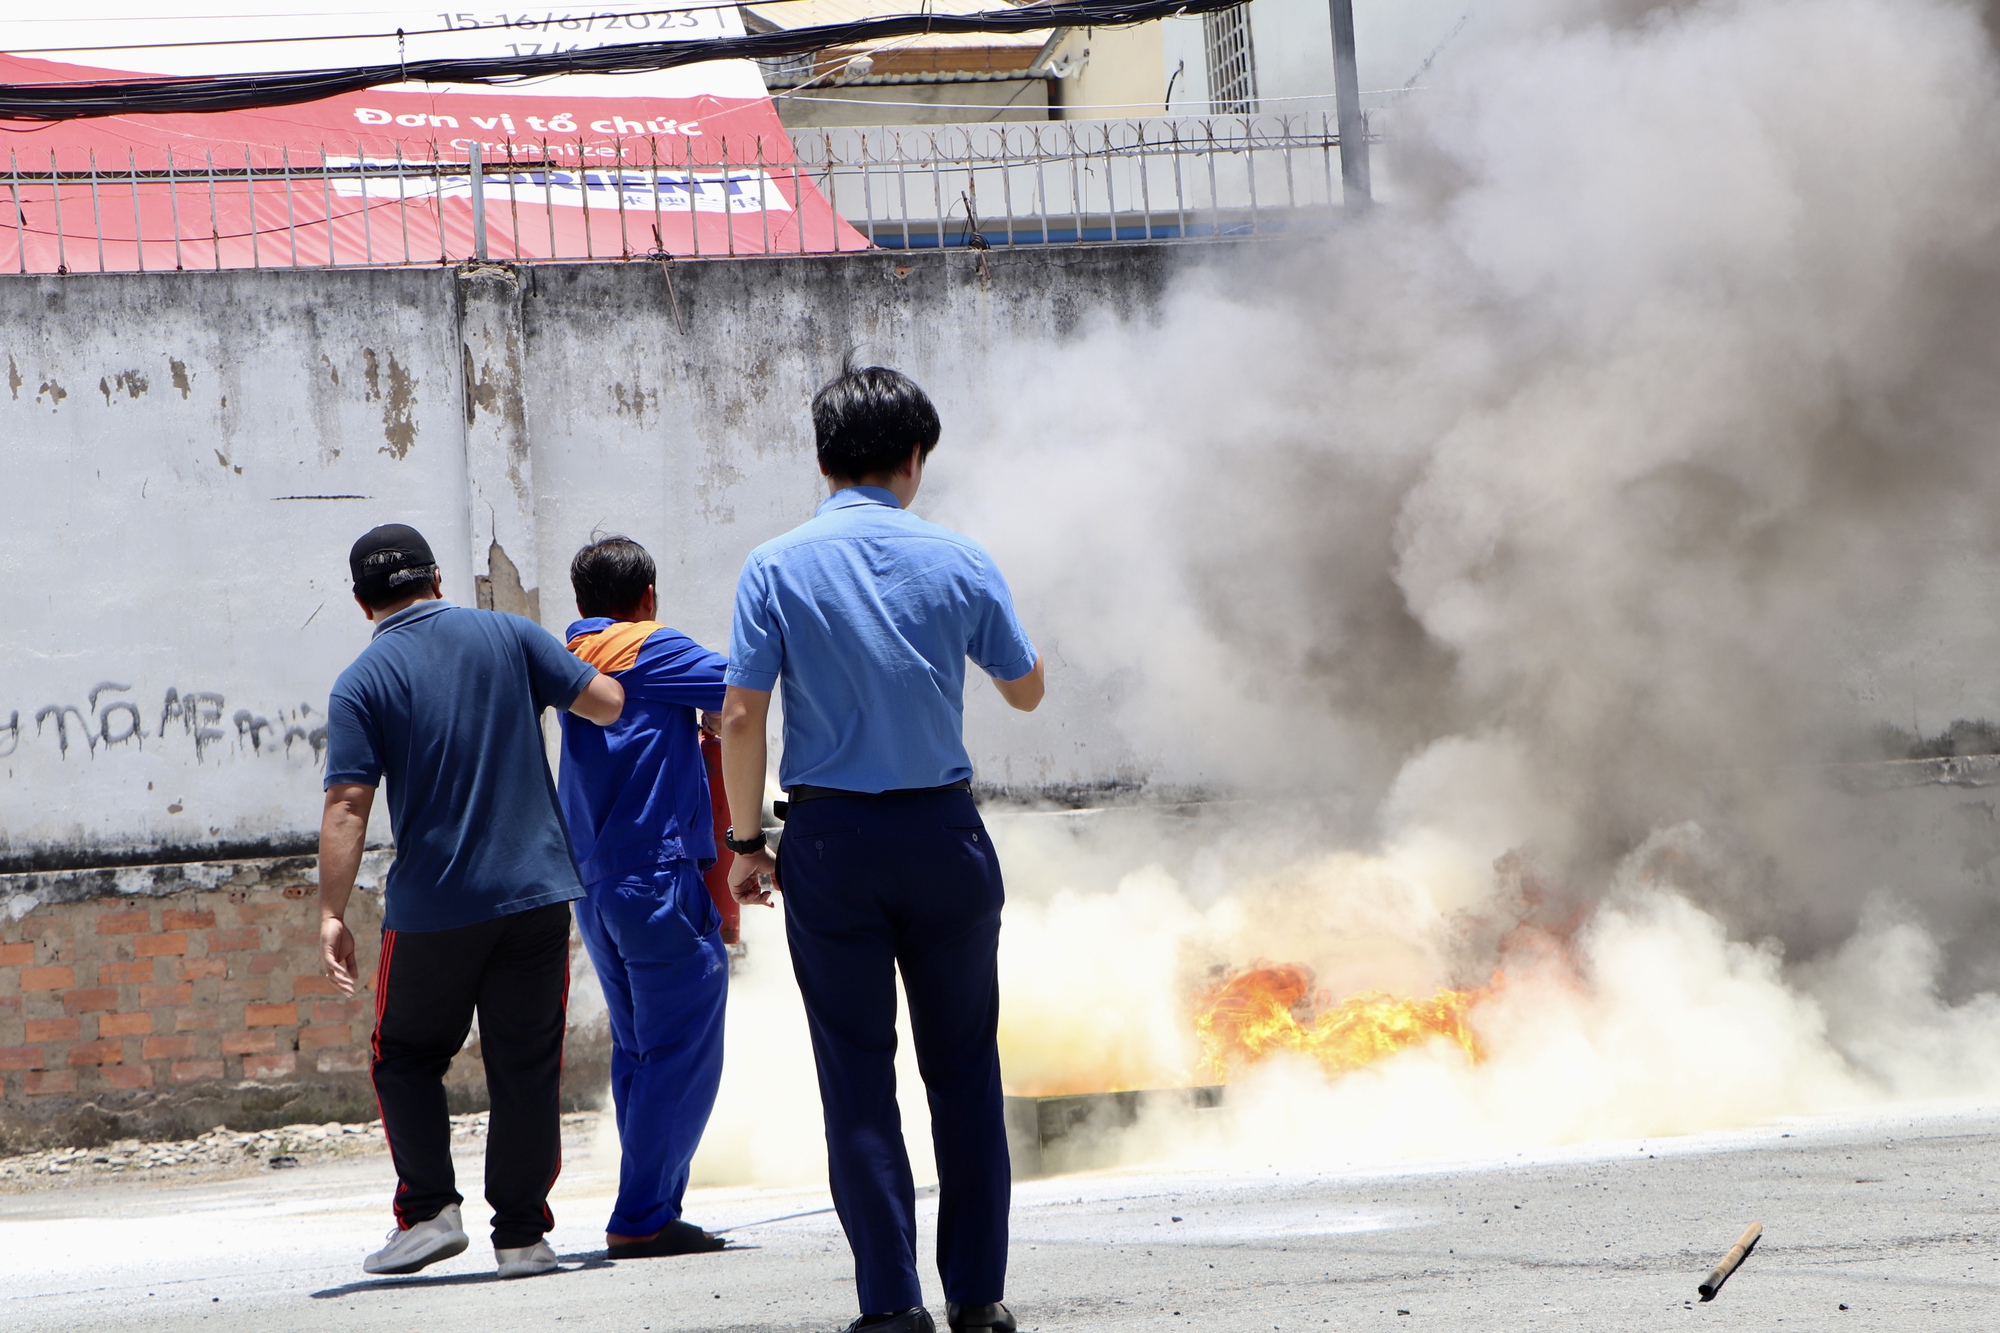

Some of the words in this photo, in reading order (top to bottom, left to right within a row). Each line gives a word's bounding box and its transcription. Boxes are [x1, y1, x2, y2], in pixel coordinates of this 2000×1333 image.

[354, 107, 459, 129] Đơn
[469, 113, 517, 135] vị
[526, 112, 578, 133] tổ
[590, 116, 703, 137] chức
[450, 138, 630, 157] Organizer
[349, 162, 753, 195] ORIENT
